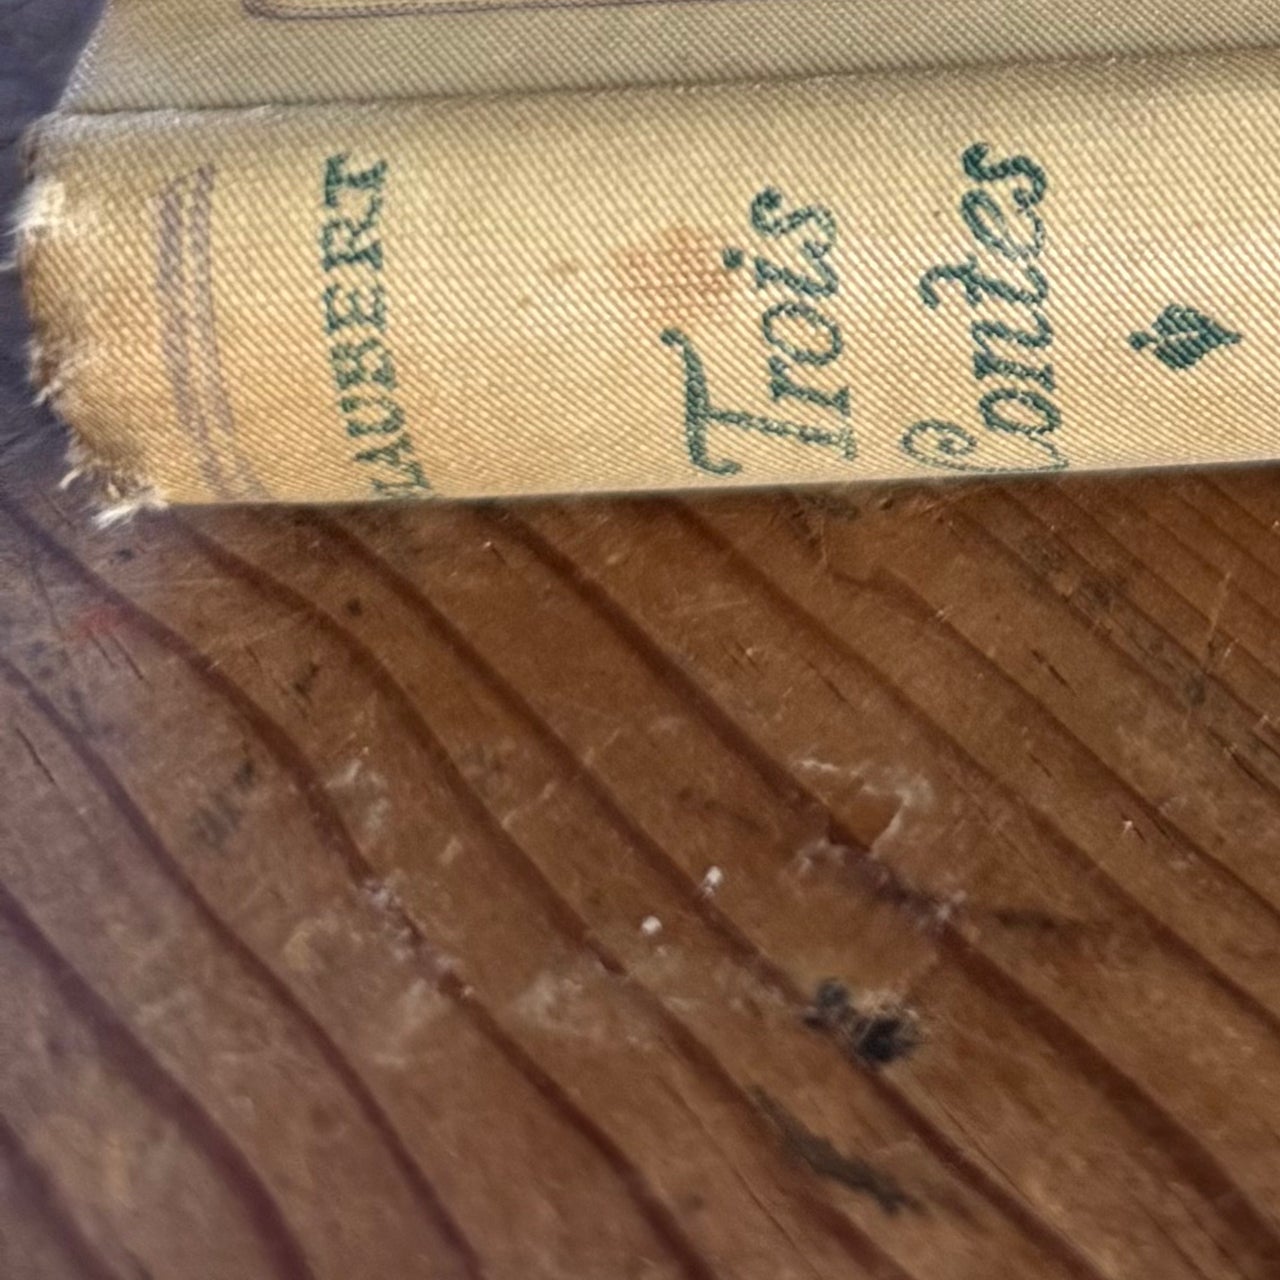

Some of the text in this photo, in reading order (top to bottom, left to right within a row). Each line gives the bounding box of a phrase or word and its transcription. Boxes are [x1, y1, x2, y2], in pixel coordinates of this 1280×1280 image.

[323, 154, 432, 498] LAUBERT
[660, 187, 858, 477] Trois
[900, 141, 1069, 473] Contes
